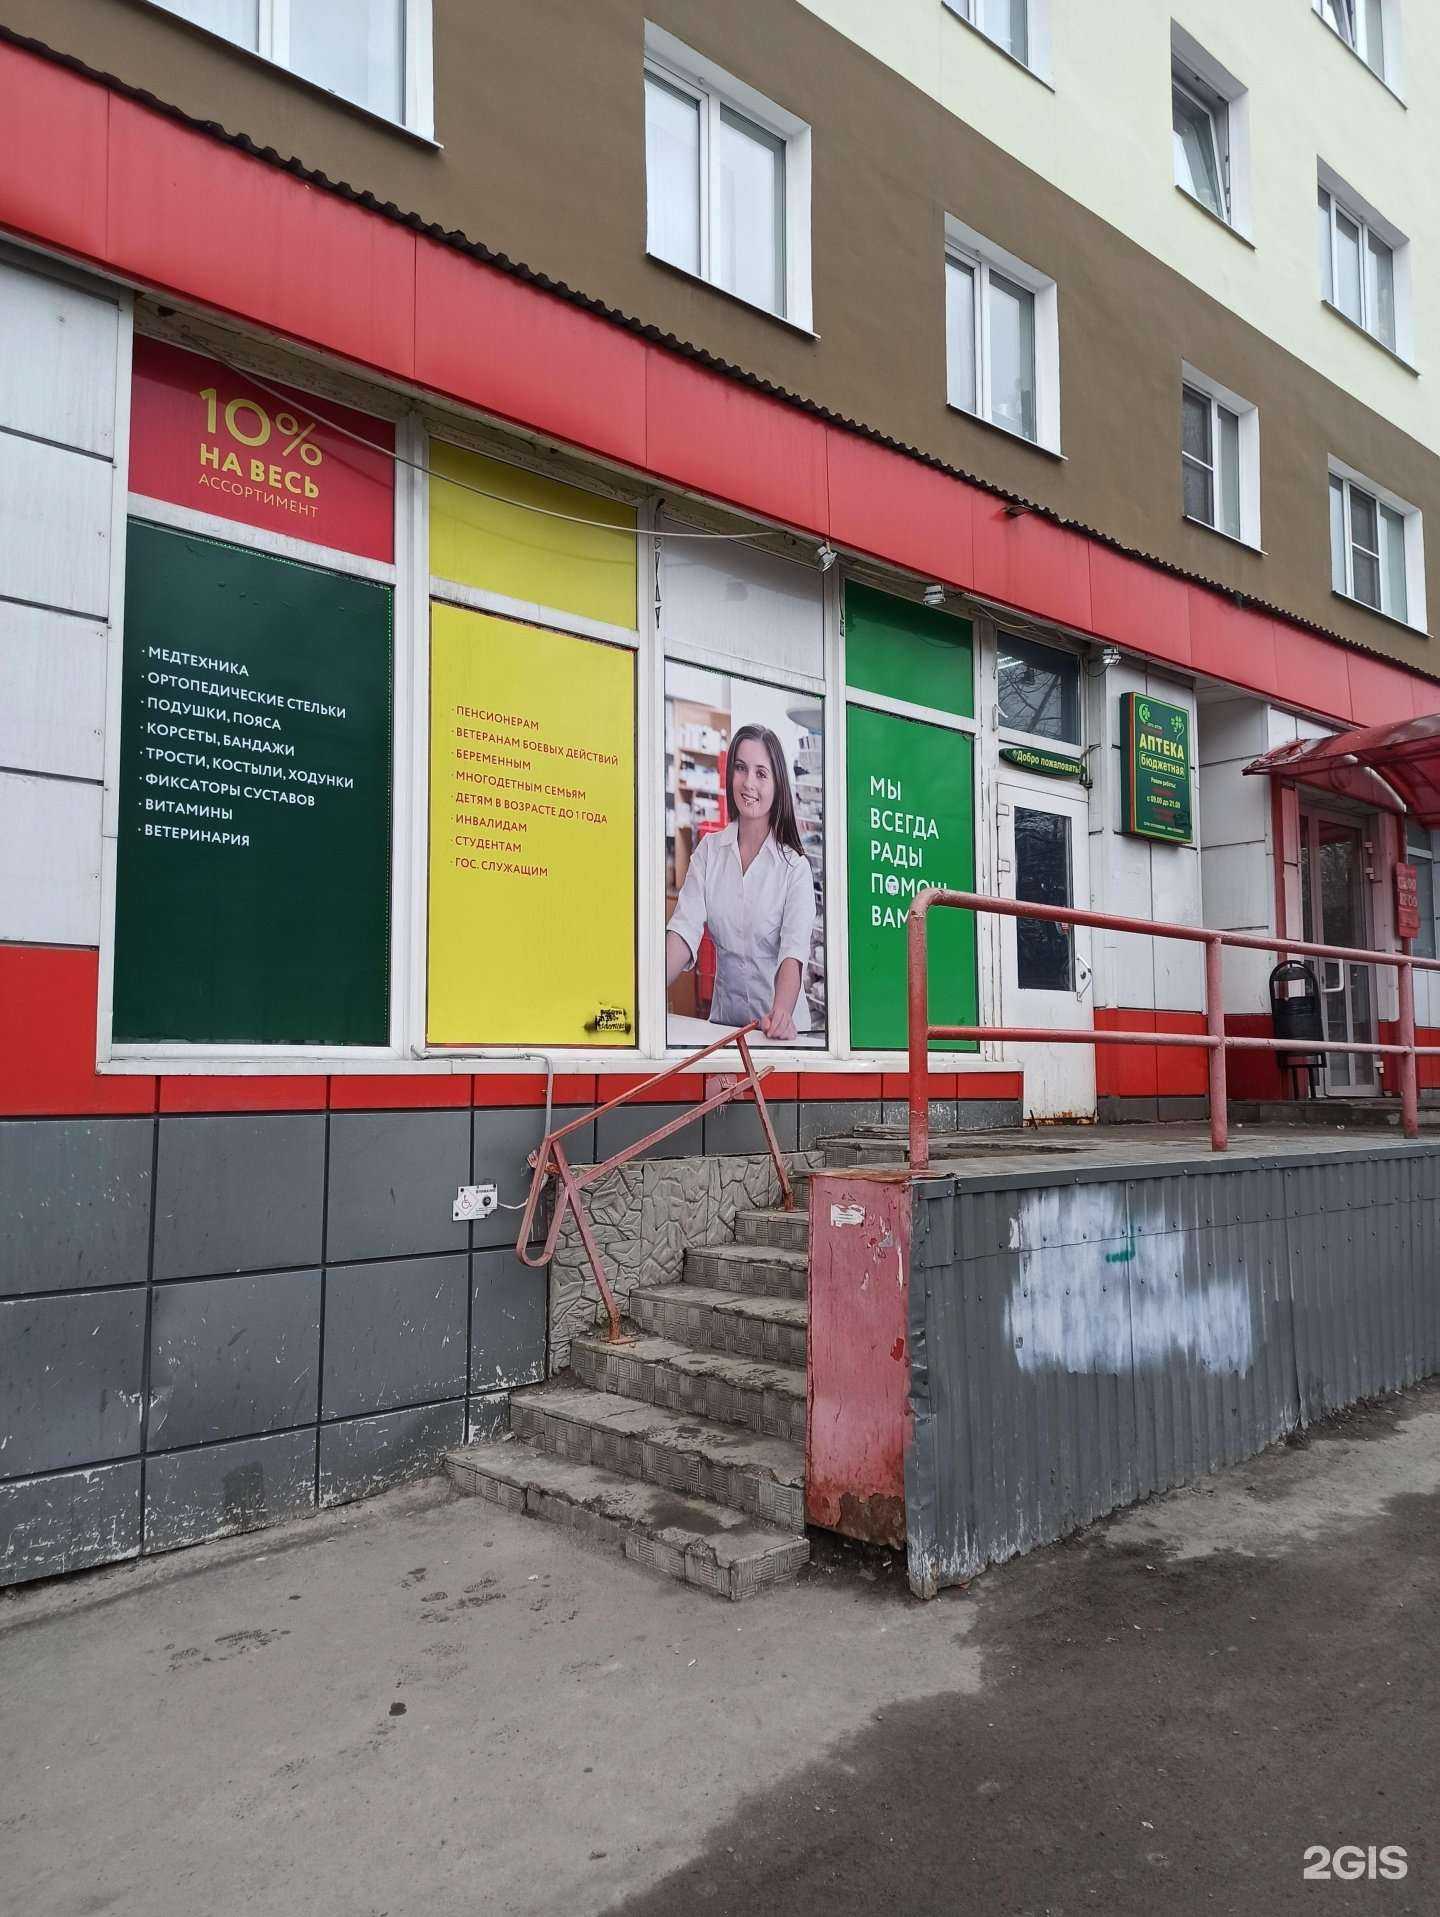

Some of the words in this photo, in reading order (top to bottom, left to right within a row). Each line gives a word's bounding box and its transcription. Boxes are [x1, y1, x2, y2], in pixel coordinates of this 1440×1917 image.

[200, 388, 323, 467] 10%
[199, 443, 243, 477] НА
[250, 458, 320, 499] ВЕСЬ
[198, 473, 319, 517] АССОРТИМЕНТ
[148, 646, 249, 677] МЕДТЕХНИКА
[147, 672, 284, 707] ОРТОПЕДИЧЕСКИЕ
[287, 698, 346, 719] СТЕЛЬКИ
[147, 697, 231, 723] ПОДУШКИ,
[233, 711, 281, 731] ПОЯСА
[456, 705, 539, 731] ПЕНСИОНЕРАМ
[147, 722, 220, 747] КОРСЕТЫ,
[223, 734, 295, 757] БАНДАЖИ
[456, 727, 520, 749] ВЕТЕРАНАМ
[522, 739, 564, 756] БОЕВЫХ
[566, 748, 618, 766] ДЕЙСТВИЙ
[1139, 733, 1185, 760] АПТЕКА
[146, 748, 210, 770] ТРОСТИ,
[212, 757, 286, 781] КОСТЫЛИ,
[288, 769, 354, 790] ХОДУНКИ
[456, 748, 531, 771] БЕРЕМЕННЫМ
[1016, 750, 1040, 765] Добро
[1141, 754, 1185, 777] бюджетная
[145, 772, 241, 798] ФИКСАТОРЫ
[243, 786, 315, 808] СУСТАВОВ
[456, 770, 542, 793] МНОГОДЕТНЫМ
[544, 785, 586, 800] СЕМЬЯМ
[870, 775, 901, 801] МЫ
[145, 798, 233, 821] ВИТАМИНЫ
[455, 792, 492, 806] ДЕТЯМ
[495, 797, 502, 808] В
[504, 799, 556, 817] ВОЗРАСТЕ
[558, 808, 574, 820] ДО
[575, 810, 579, 820] 1
[581, 811, 608, 824] ГОДА
[144, 823, 250, 847] ВЕТЕРИНАРИЯ
[455, 813, 527, 833] ИНВАЛИДАМ
[870, 807, 939, 841] ВСЕГДА
[455, 835, 522, 853] СТУДЕНТАМ
[871, 840, 923, 869] РАДЫ
[455, 857, 479, 870] ГОС.
[481, 860, 548, 877] СЛУЖАЩИМ
[871, 872, 948, 898] ПОМО
